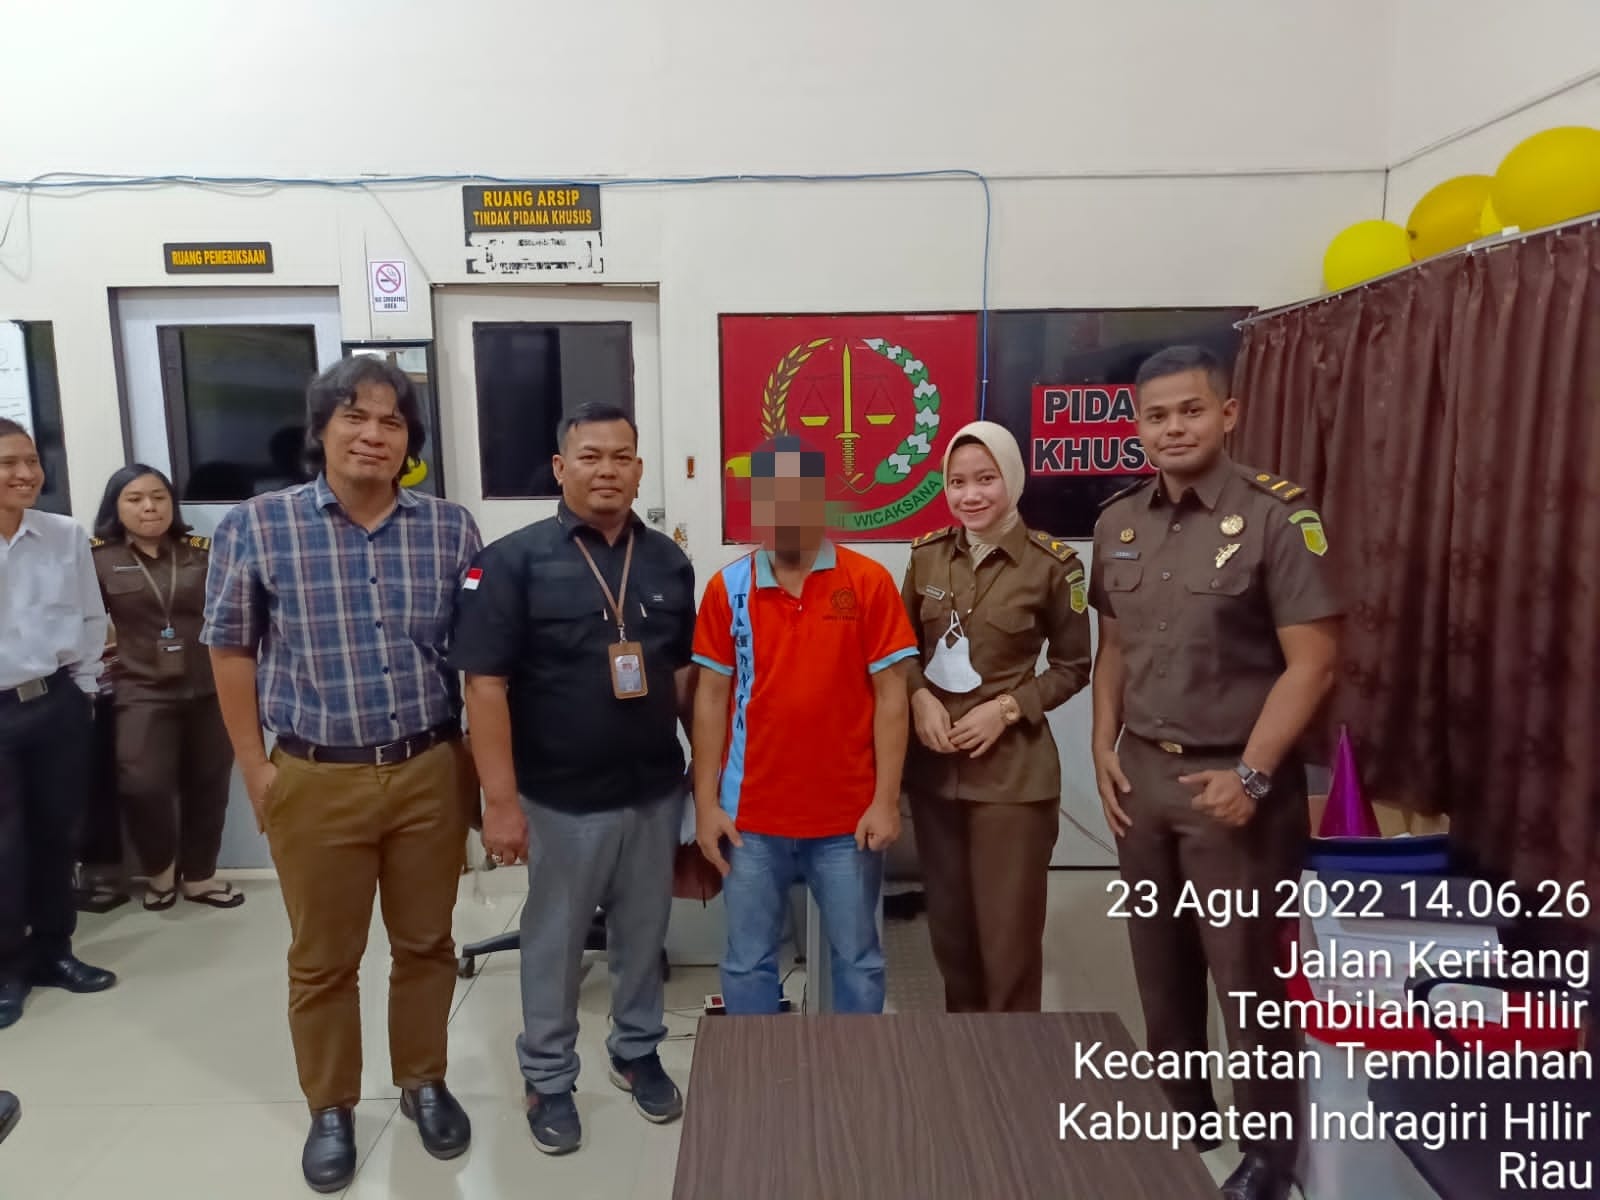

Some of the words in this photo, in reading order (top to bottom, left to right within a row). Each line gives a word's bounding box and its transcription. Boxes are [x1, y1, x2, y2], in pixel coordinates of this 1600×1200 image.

[483, 190, 533, 207] RUANG
[537, 189, 580, 207] ARSIP
[473, 211, 511, 225] TINDAK
[513, 210, 549, 225] PIDANA
[551, 209, 592, 224] KHUSUS
[171, 250, 202, 265] RUANG
[203, 249, 266, 265] PEMERIKSAAN
[1032, 436, 1160, 473] KHUS
[854, 479, 941, 528] WICAKSANA
